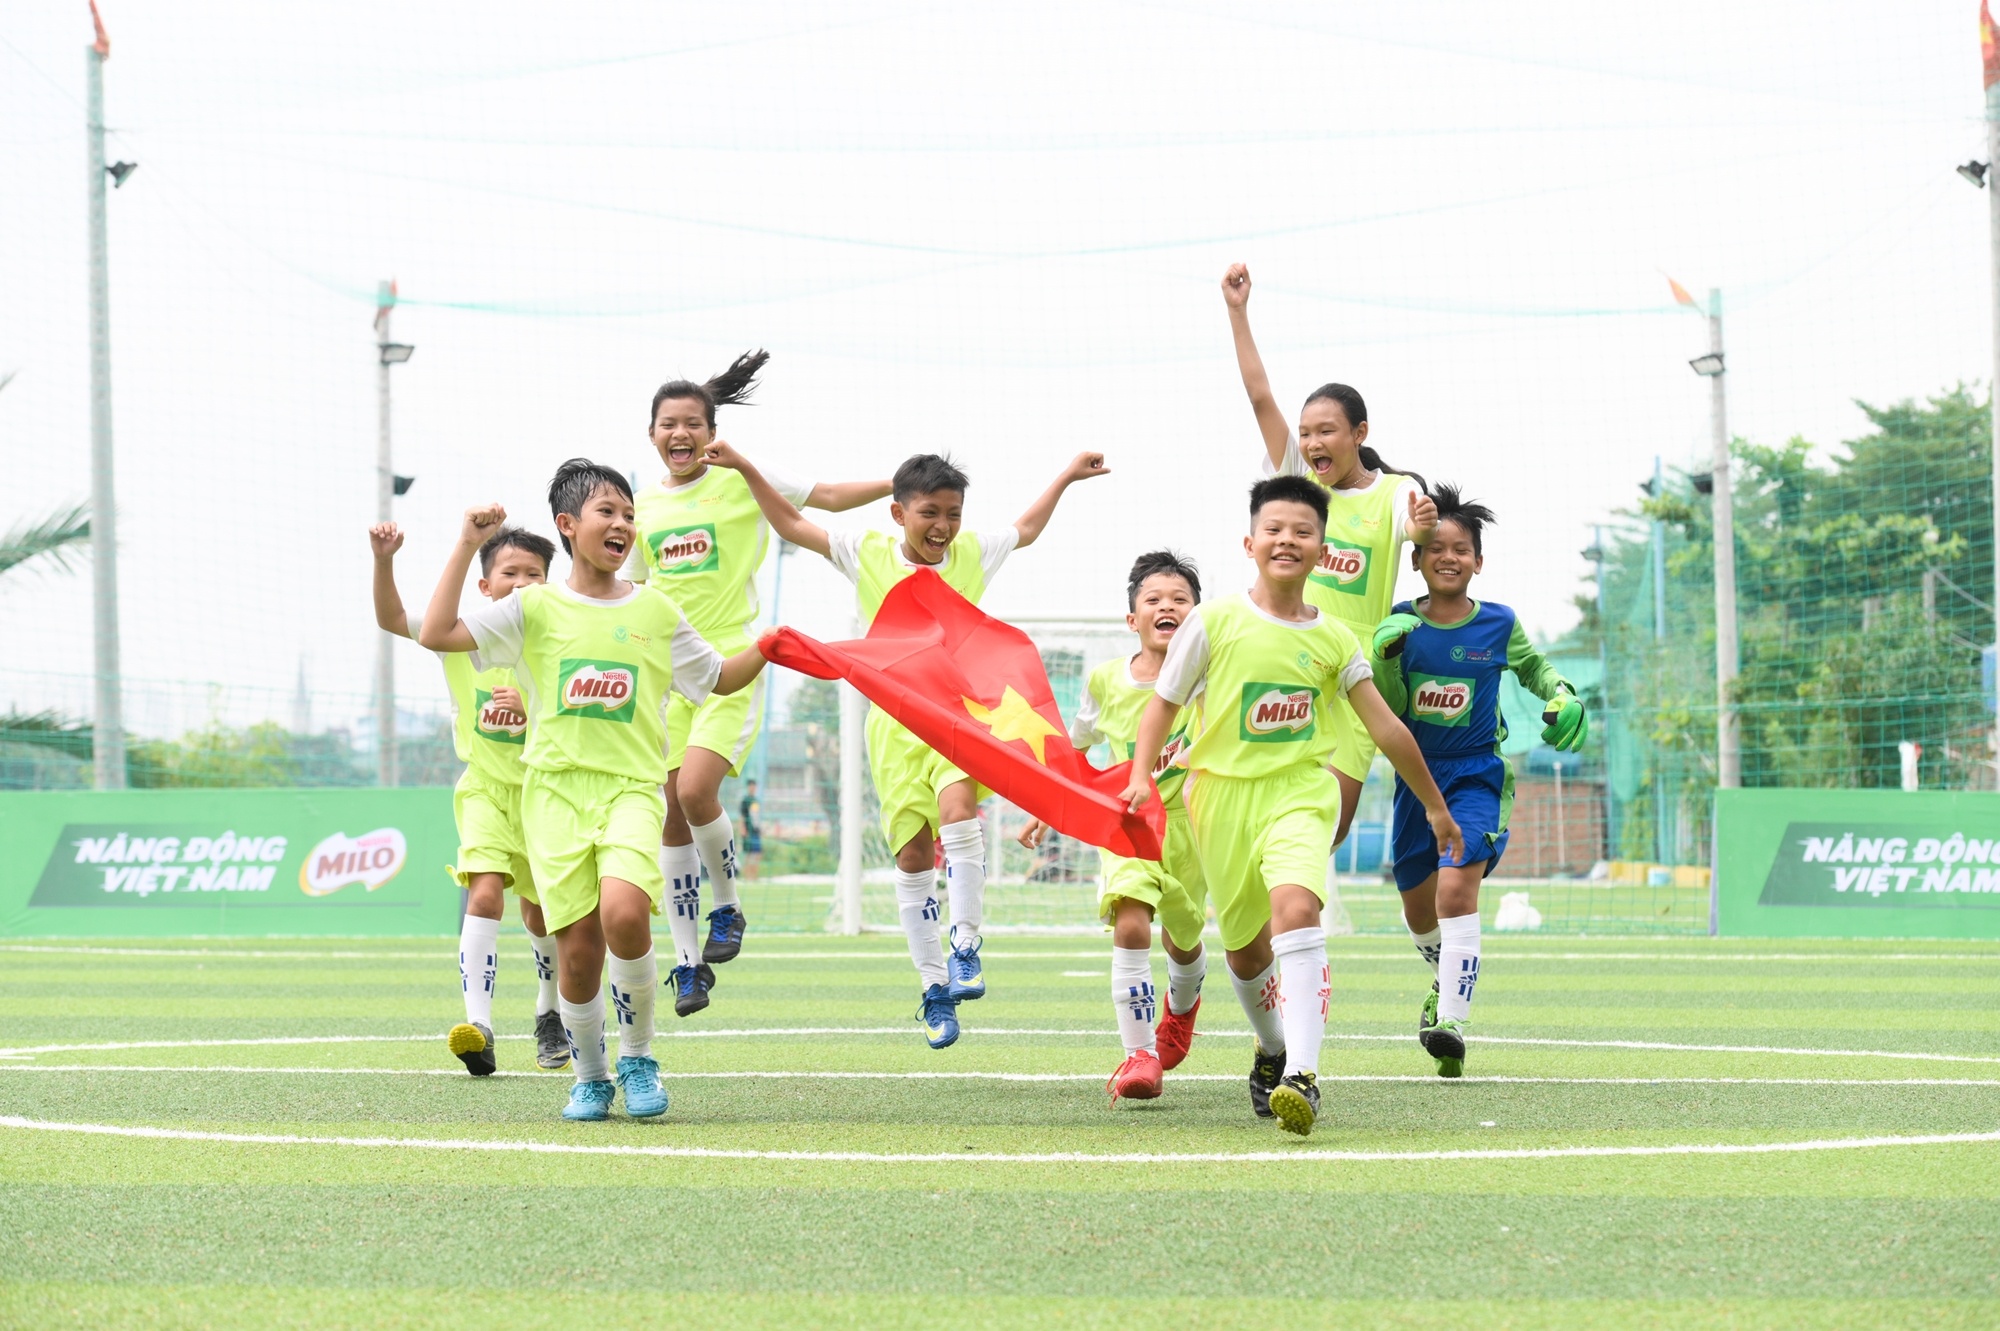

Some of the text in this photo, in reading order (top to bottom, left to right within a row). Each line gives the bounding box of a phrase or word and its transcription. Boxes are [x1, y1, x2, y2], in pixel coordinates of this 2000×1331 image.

[664, 540, 707, 560] MILO
[602, 672, 628, 681] Nestlé
[570, 678, 628, 699] MILO
[1418, 691, 1464, 709] MILO
[1256, 702, 1309, 722] MILO
[315, 847, 395, 880] MILO
[101, 862, 277, 897] VIỆT NAM
[1828, 863, 1918, 897] VIỆT
